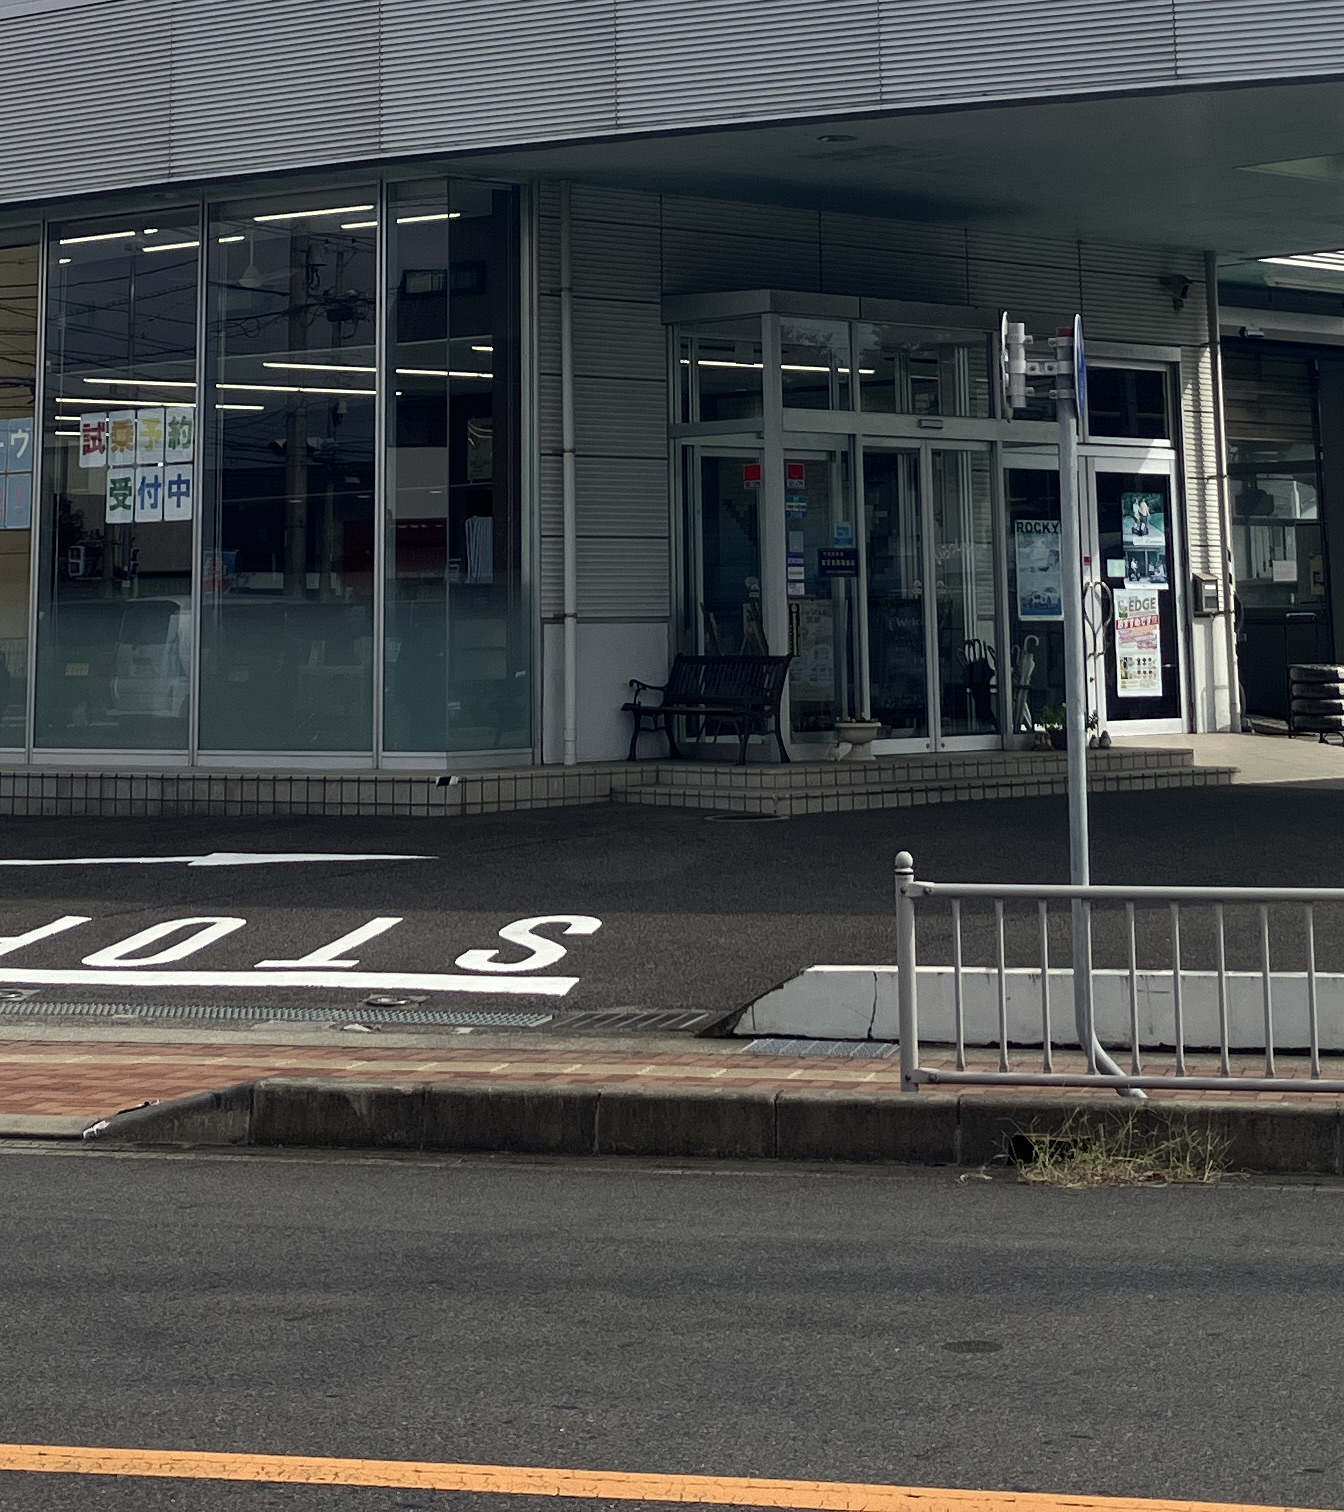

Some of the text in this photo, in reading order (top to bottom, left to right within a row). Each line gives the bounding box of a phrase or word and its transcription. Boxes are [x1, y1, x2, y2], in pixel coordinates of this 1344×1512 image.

[82, 415, 193, 456] 試乗予約
[109, 472, 191, 512] 受付中
[1016, 521, 1059, 534] ROCKY
[1128, 597, 1157, 612] EDGE
